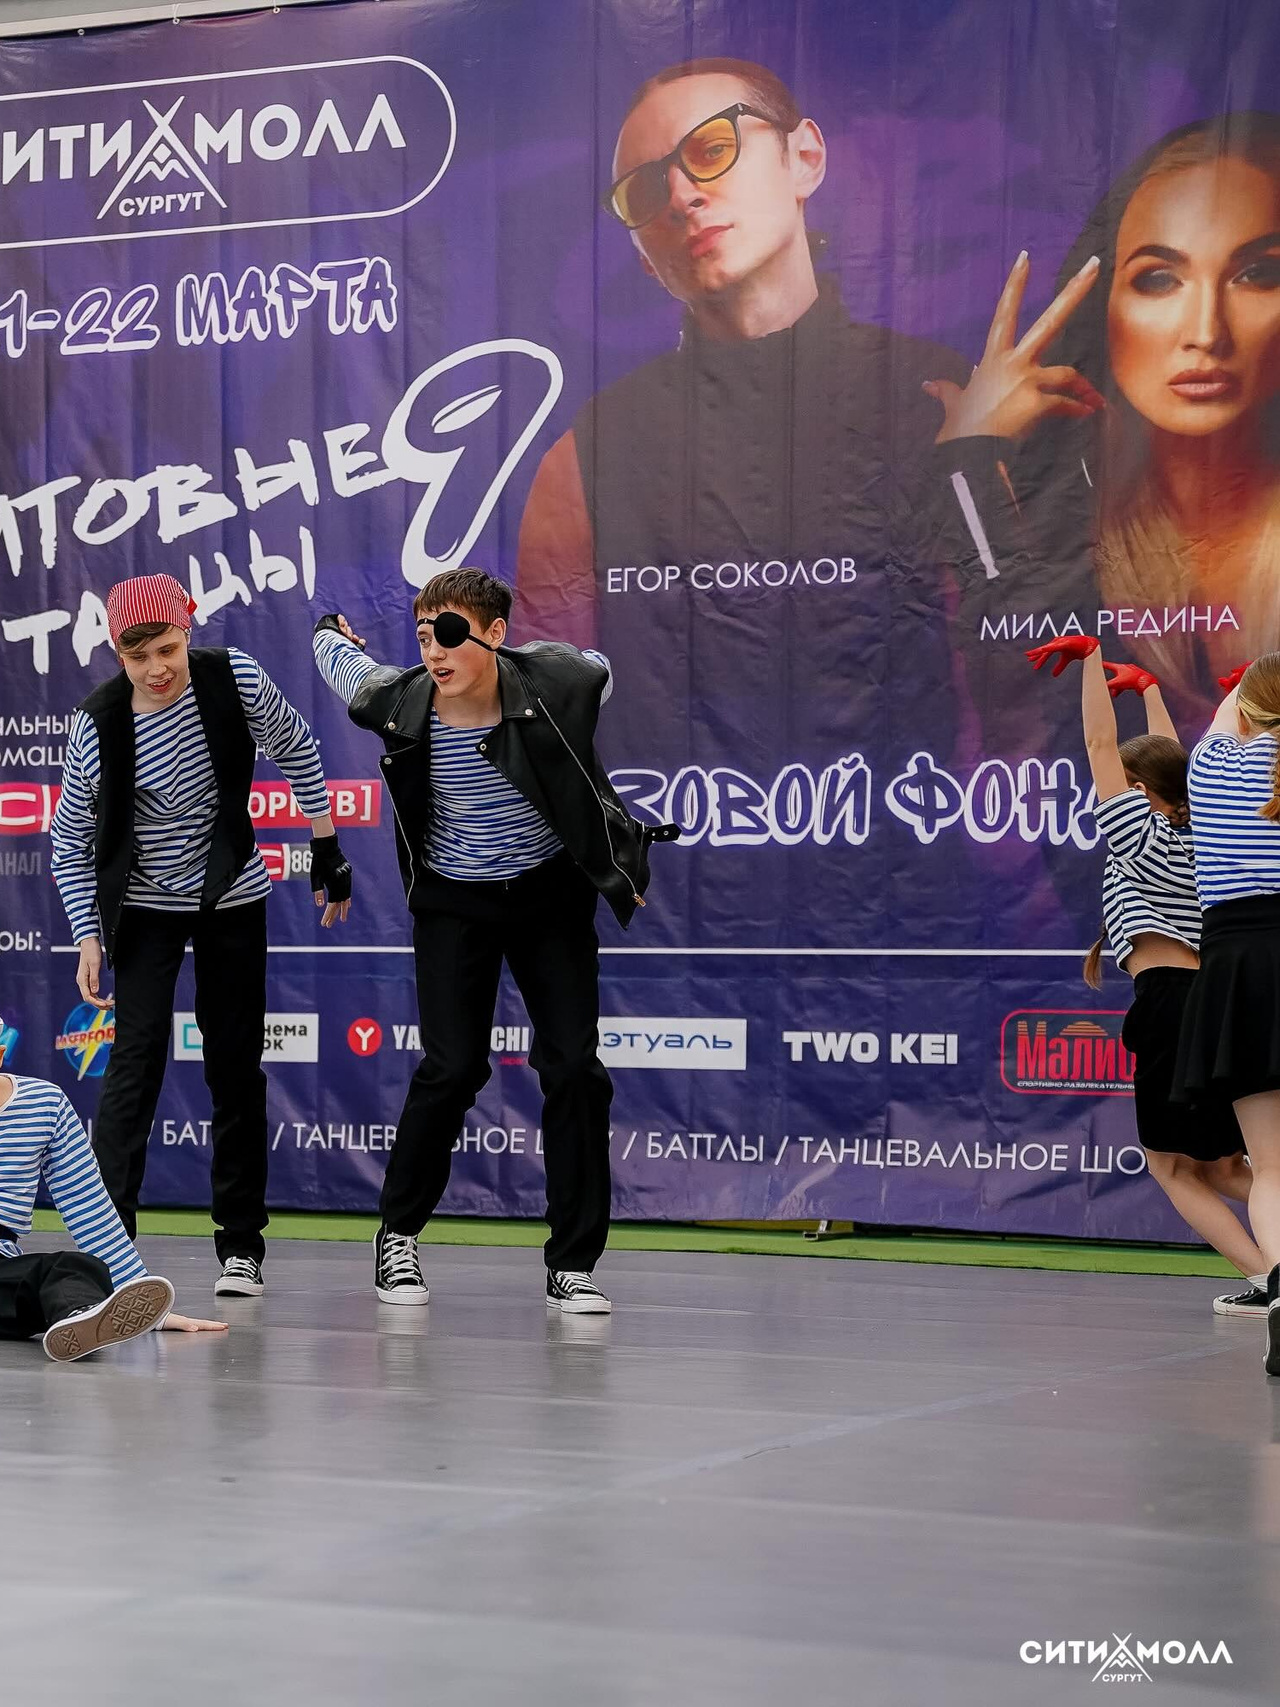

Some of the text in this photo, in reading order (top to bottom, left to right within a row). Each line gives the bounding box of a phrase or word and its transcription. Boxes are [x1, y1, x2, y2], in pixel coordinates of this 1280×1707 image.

[194, 94, 407, 165] МОЛЛ
[118, 191, 205, 217] СУРГУТ
[175, 256, 398, 347] МАРТА
[607, 557, 858, 593] ЕГОР СОКОЛОВ
[1, 525, 317, 676] ТАЦЫ
[979, 604, 1240, 641] МИЛА РЕДИНА
[599, 1032, 733, 1053] этуаль
[783, 1030, 959, 1065] TWO KEI
[647, 1131, 765, 1162] БАТТЛЫ
[798, 1135, 1070, 1172] ТАНЦЕВАЛЬНОЕ
